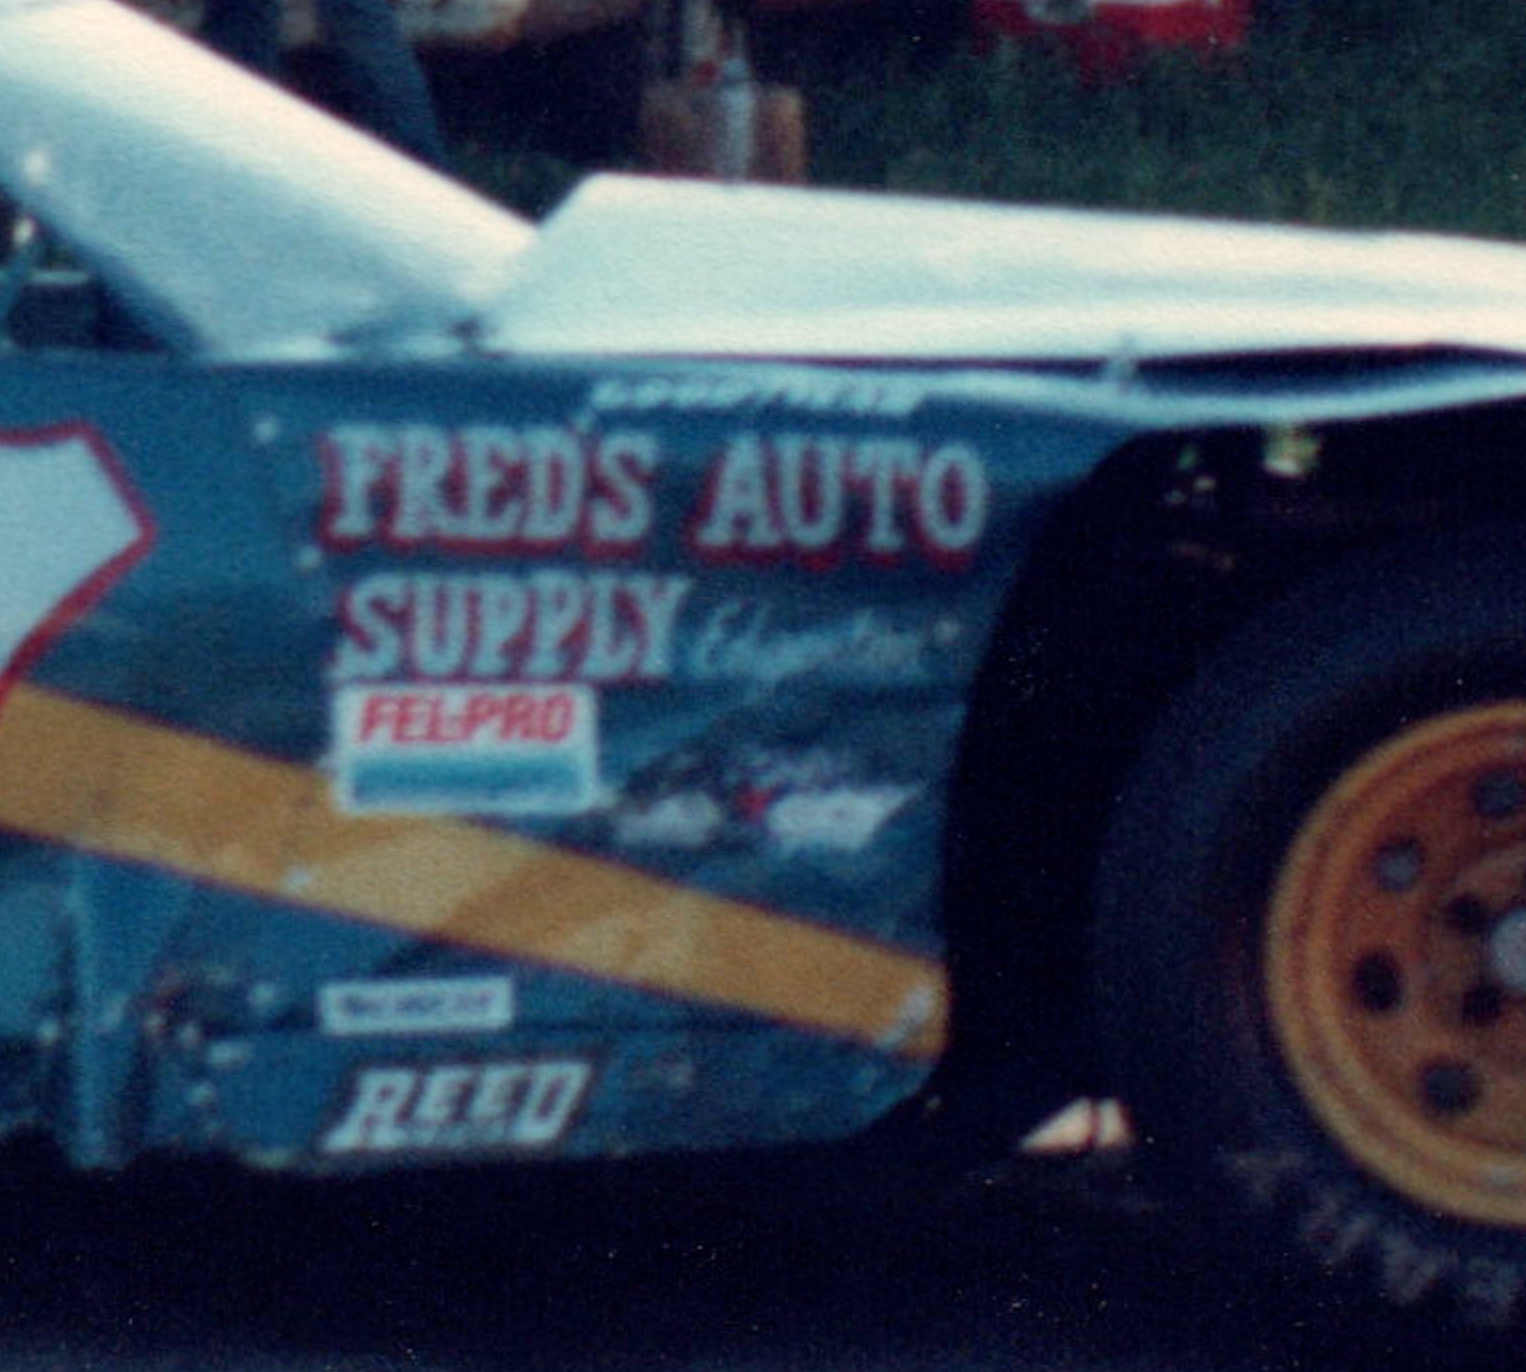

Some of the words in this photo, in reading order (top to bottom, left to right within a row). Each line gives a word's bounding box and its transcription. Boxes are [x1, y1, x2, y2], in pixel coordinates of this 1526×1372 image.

[695, 432, 990, 552] AUTO
[328, 568, 689, 681] SUPPLY
[322, 1059, 596, 1152] REED
